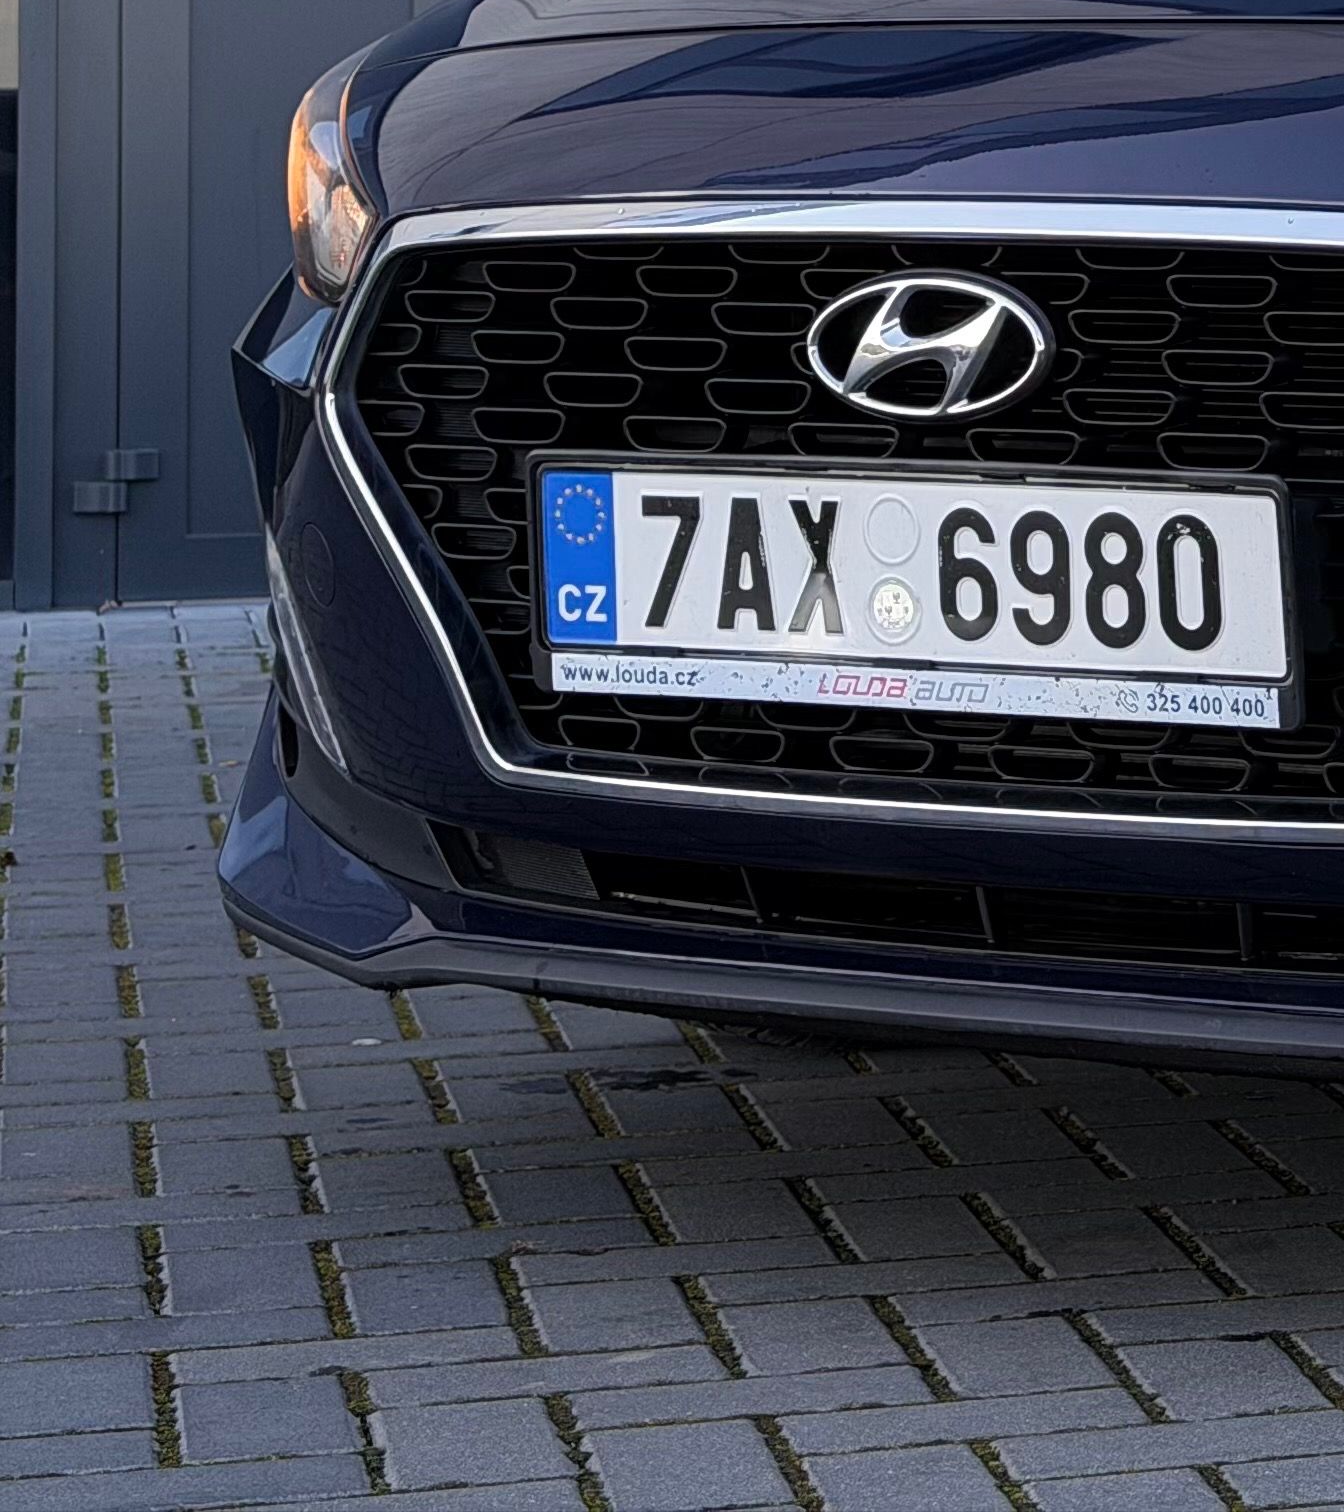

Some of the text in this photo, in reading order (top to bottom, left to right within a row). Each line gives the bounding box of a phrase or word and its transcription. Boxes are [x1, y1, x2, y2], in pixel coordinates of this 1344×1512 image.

[641, 495, 1218, 651] 7AX 6980
[557, 584, 608, 623] CZ
[562, 663, 698, 686] www.louda.cz
[1146, 693, 1265, 718] 325 400 400
